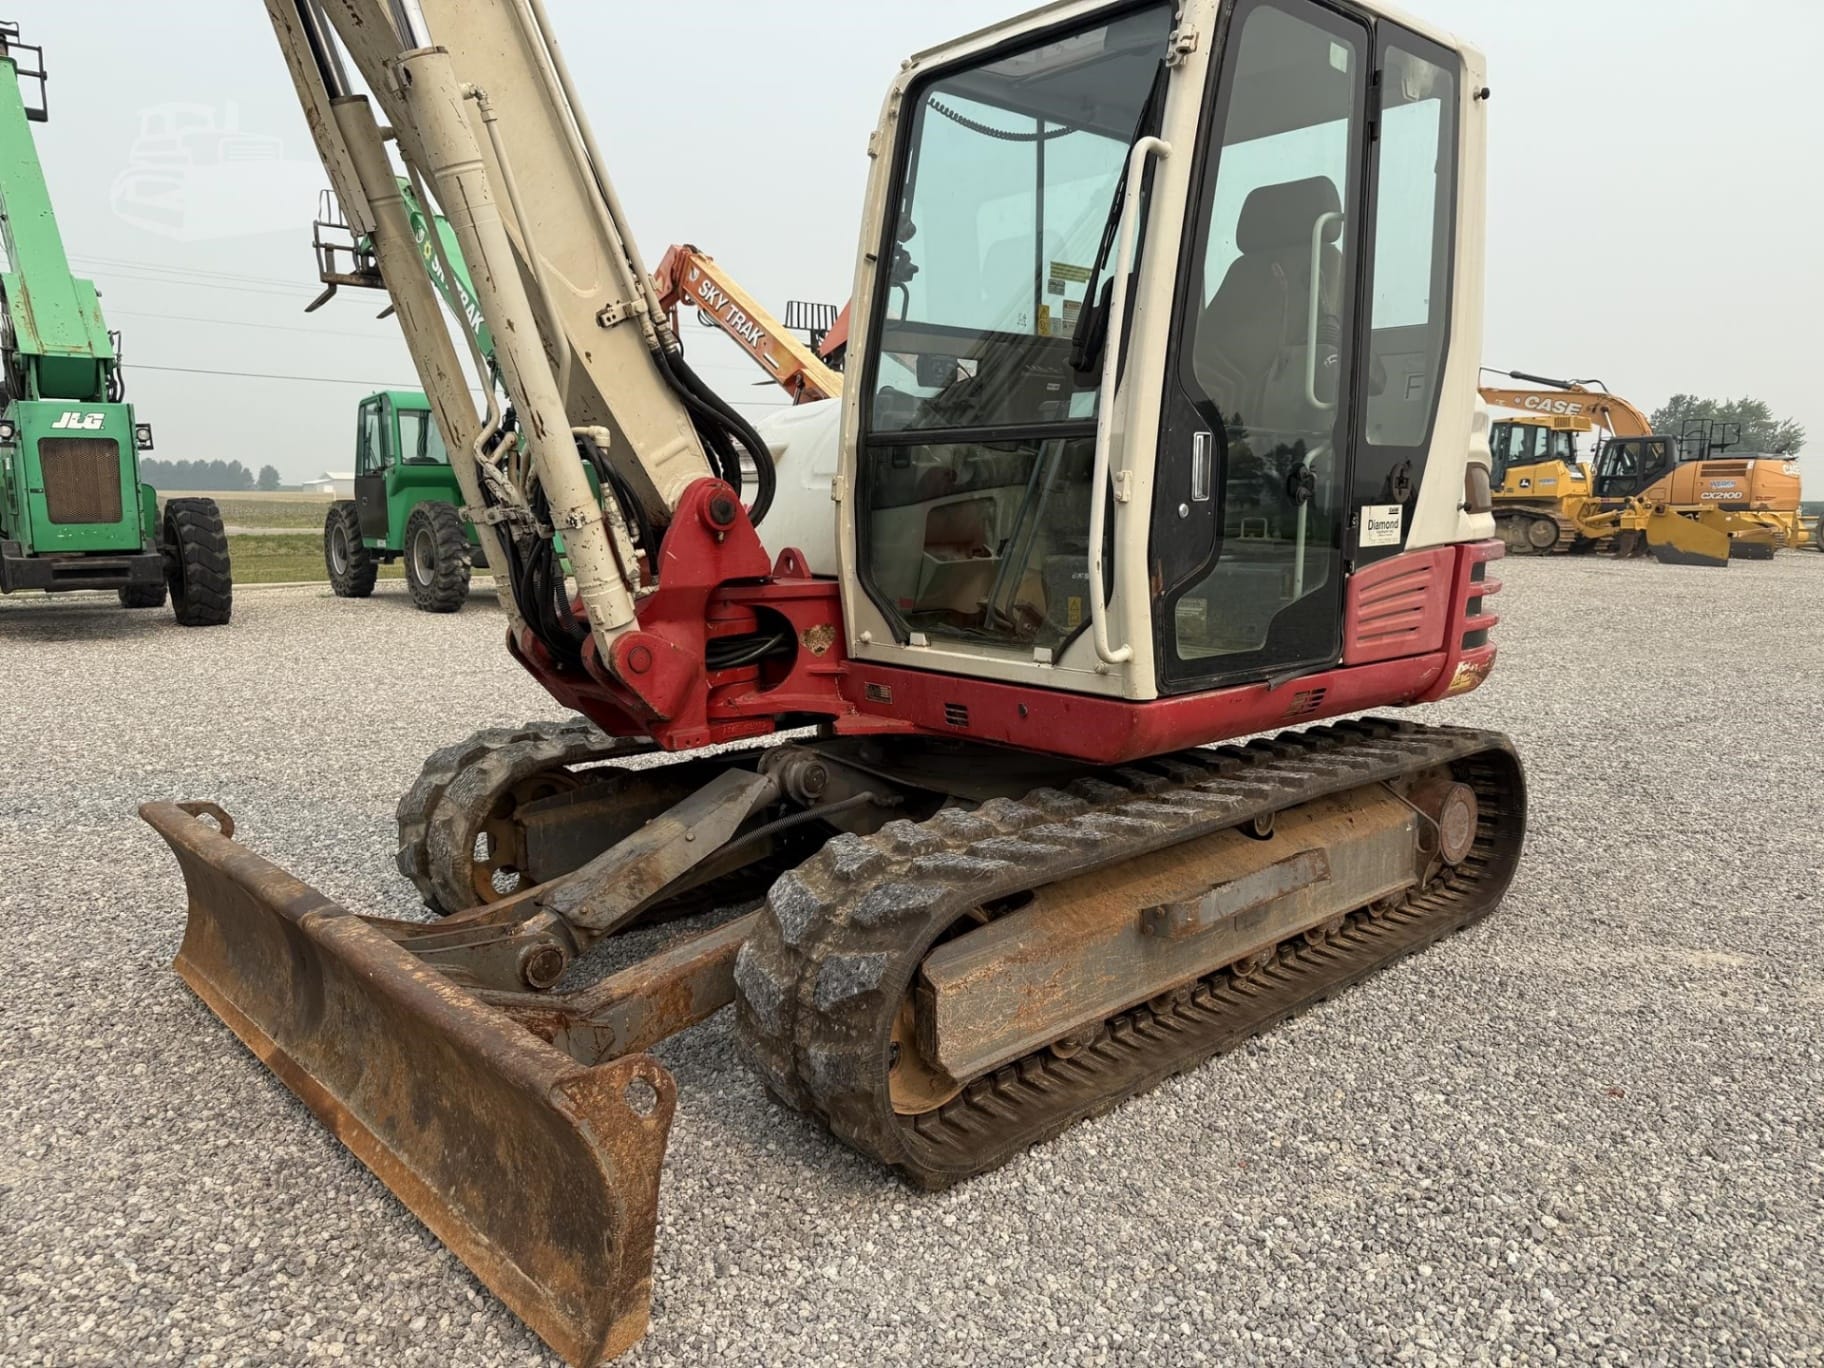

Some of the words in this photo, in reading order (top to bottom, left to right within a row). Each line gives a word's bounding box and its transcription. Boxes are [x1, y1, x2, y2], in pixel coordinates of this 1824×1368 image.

[698, 280, 728, 311] SKY
[726, 304, 764, 347] TRAK
[1525, 396, 1582, 415] CASE
[51, 412, 104, 429] JLG
[1367, 519, 1399, 530] Diamond
